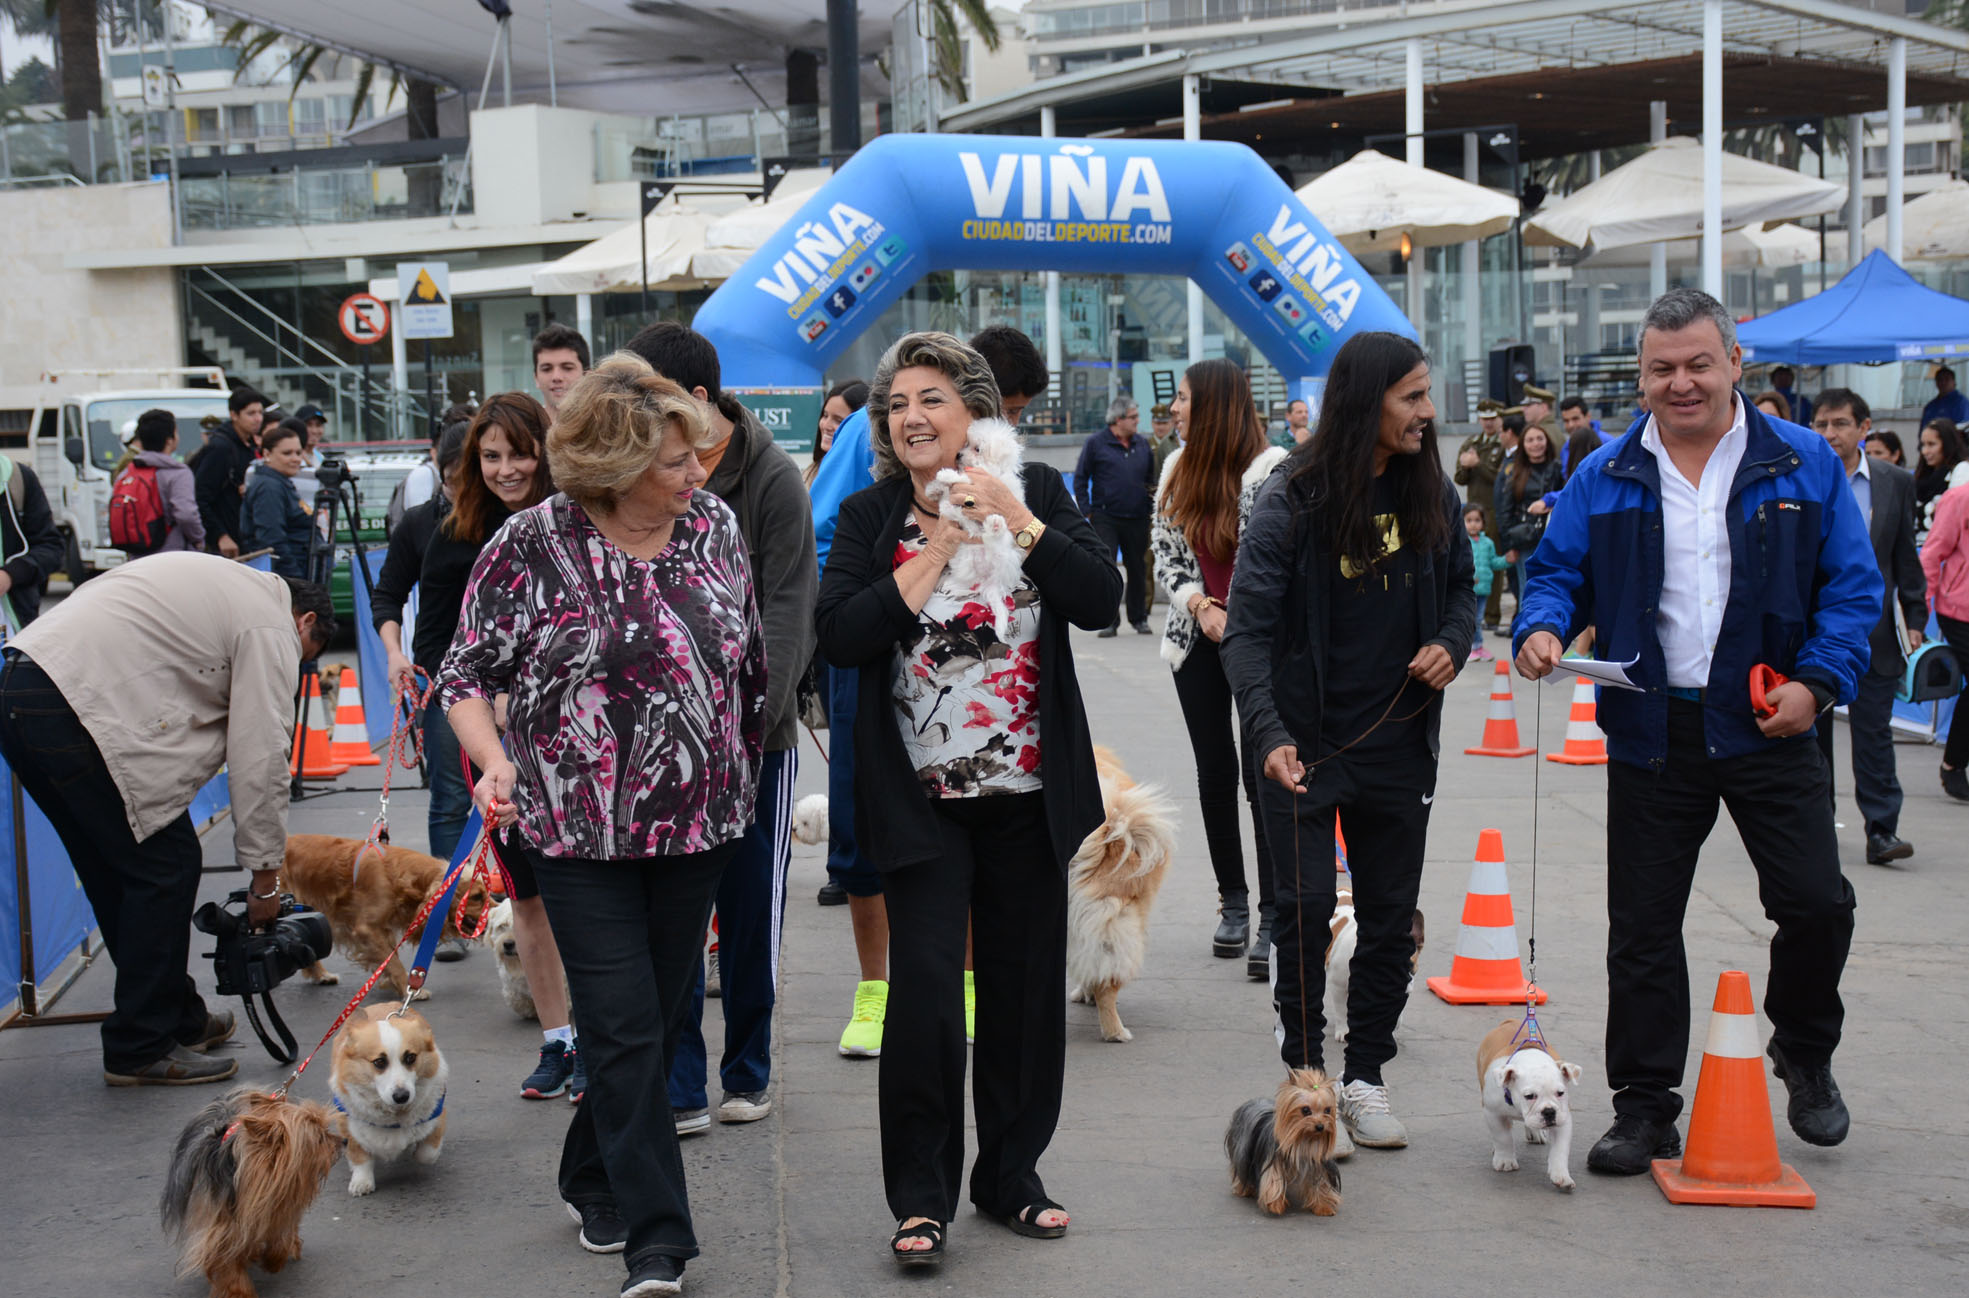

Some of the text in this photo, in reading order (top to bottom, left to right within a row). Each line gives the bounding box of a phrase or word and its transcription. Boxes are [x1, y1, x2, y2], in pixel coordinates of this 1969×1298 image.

[958, 144, 1172, 222] VIÑA
[755, 202, 874, 304] VIÑA
[962, 220, 1172, 244] CIUDADDELDEPORTE.COM
[1267, 203, 1362, 323] VIÑA
